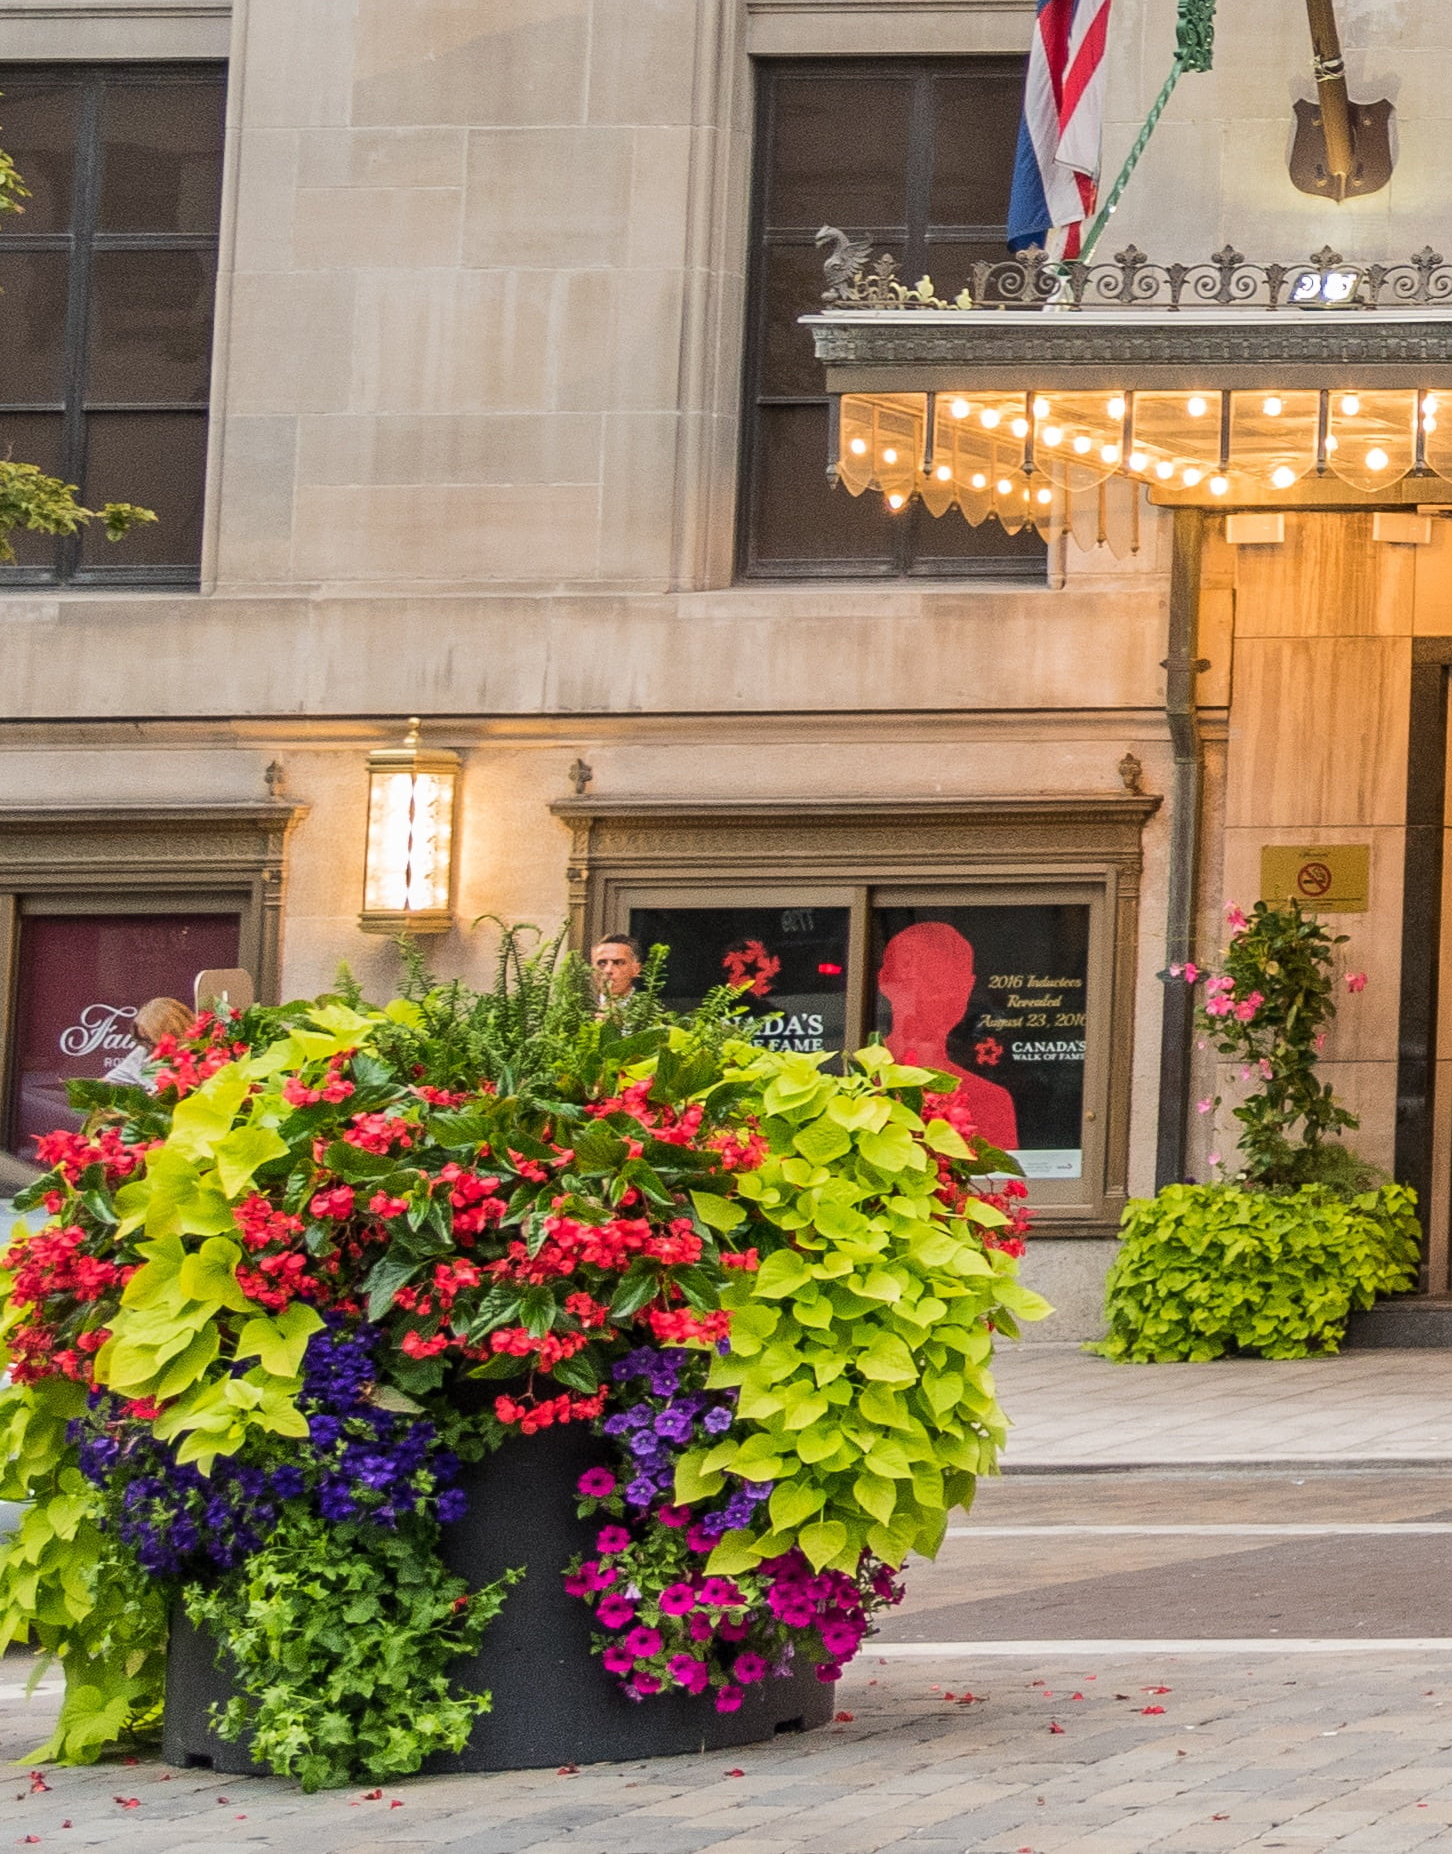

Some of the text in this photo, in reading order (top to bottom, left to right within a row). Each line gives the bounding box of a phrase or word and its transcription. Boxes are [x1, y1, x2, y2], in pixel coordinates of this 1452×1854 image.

[987, 974, 1083, 989] 2016 Inductees
[1007, 994, 1063, 1007] Revealed
[977, 1014, 1024, 1031] August
[1011, 1040, 1087, 1053] CANADA'S
[1012, 1053, 1041, 1061] WALK
